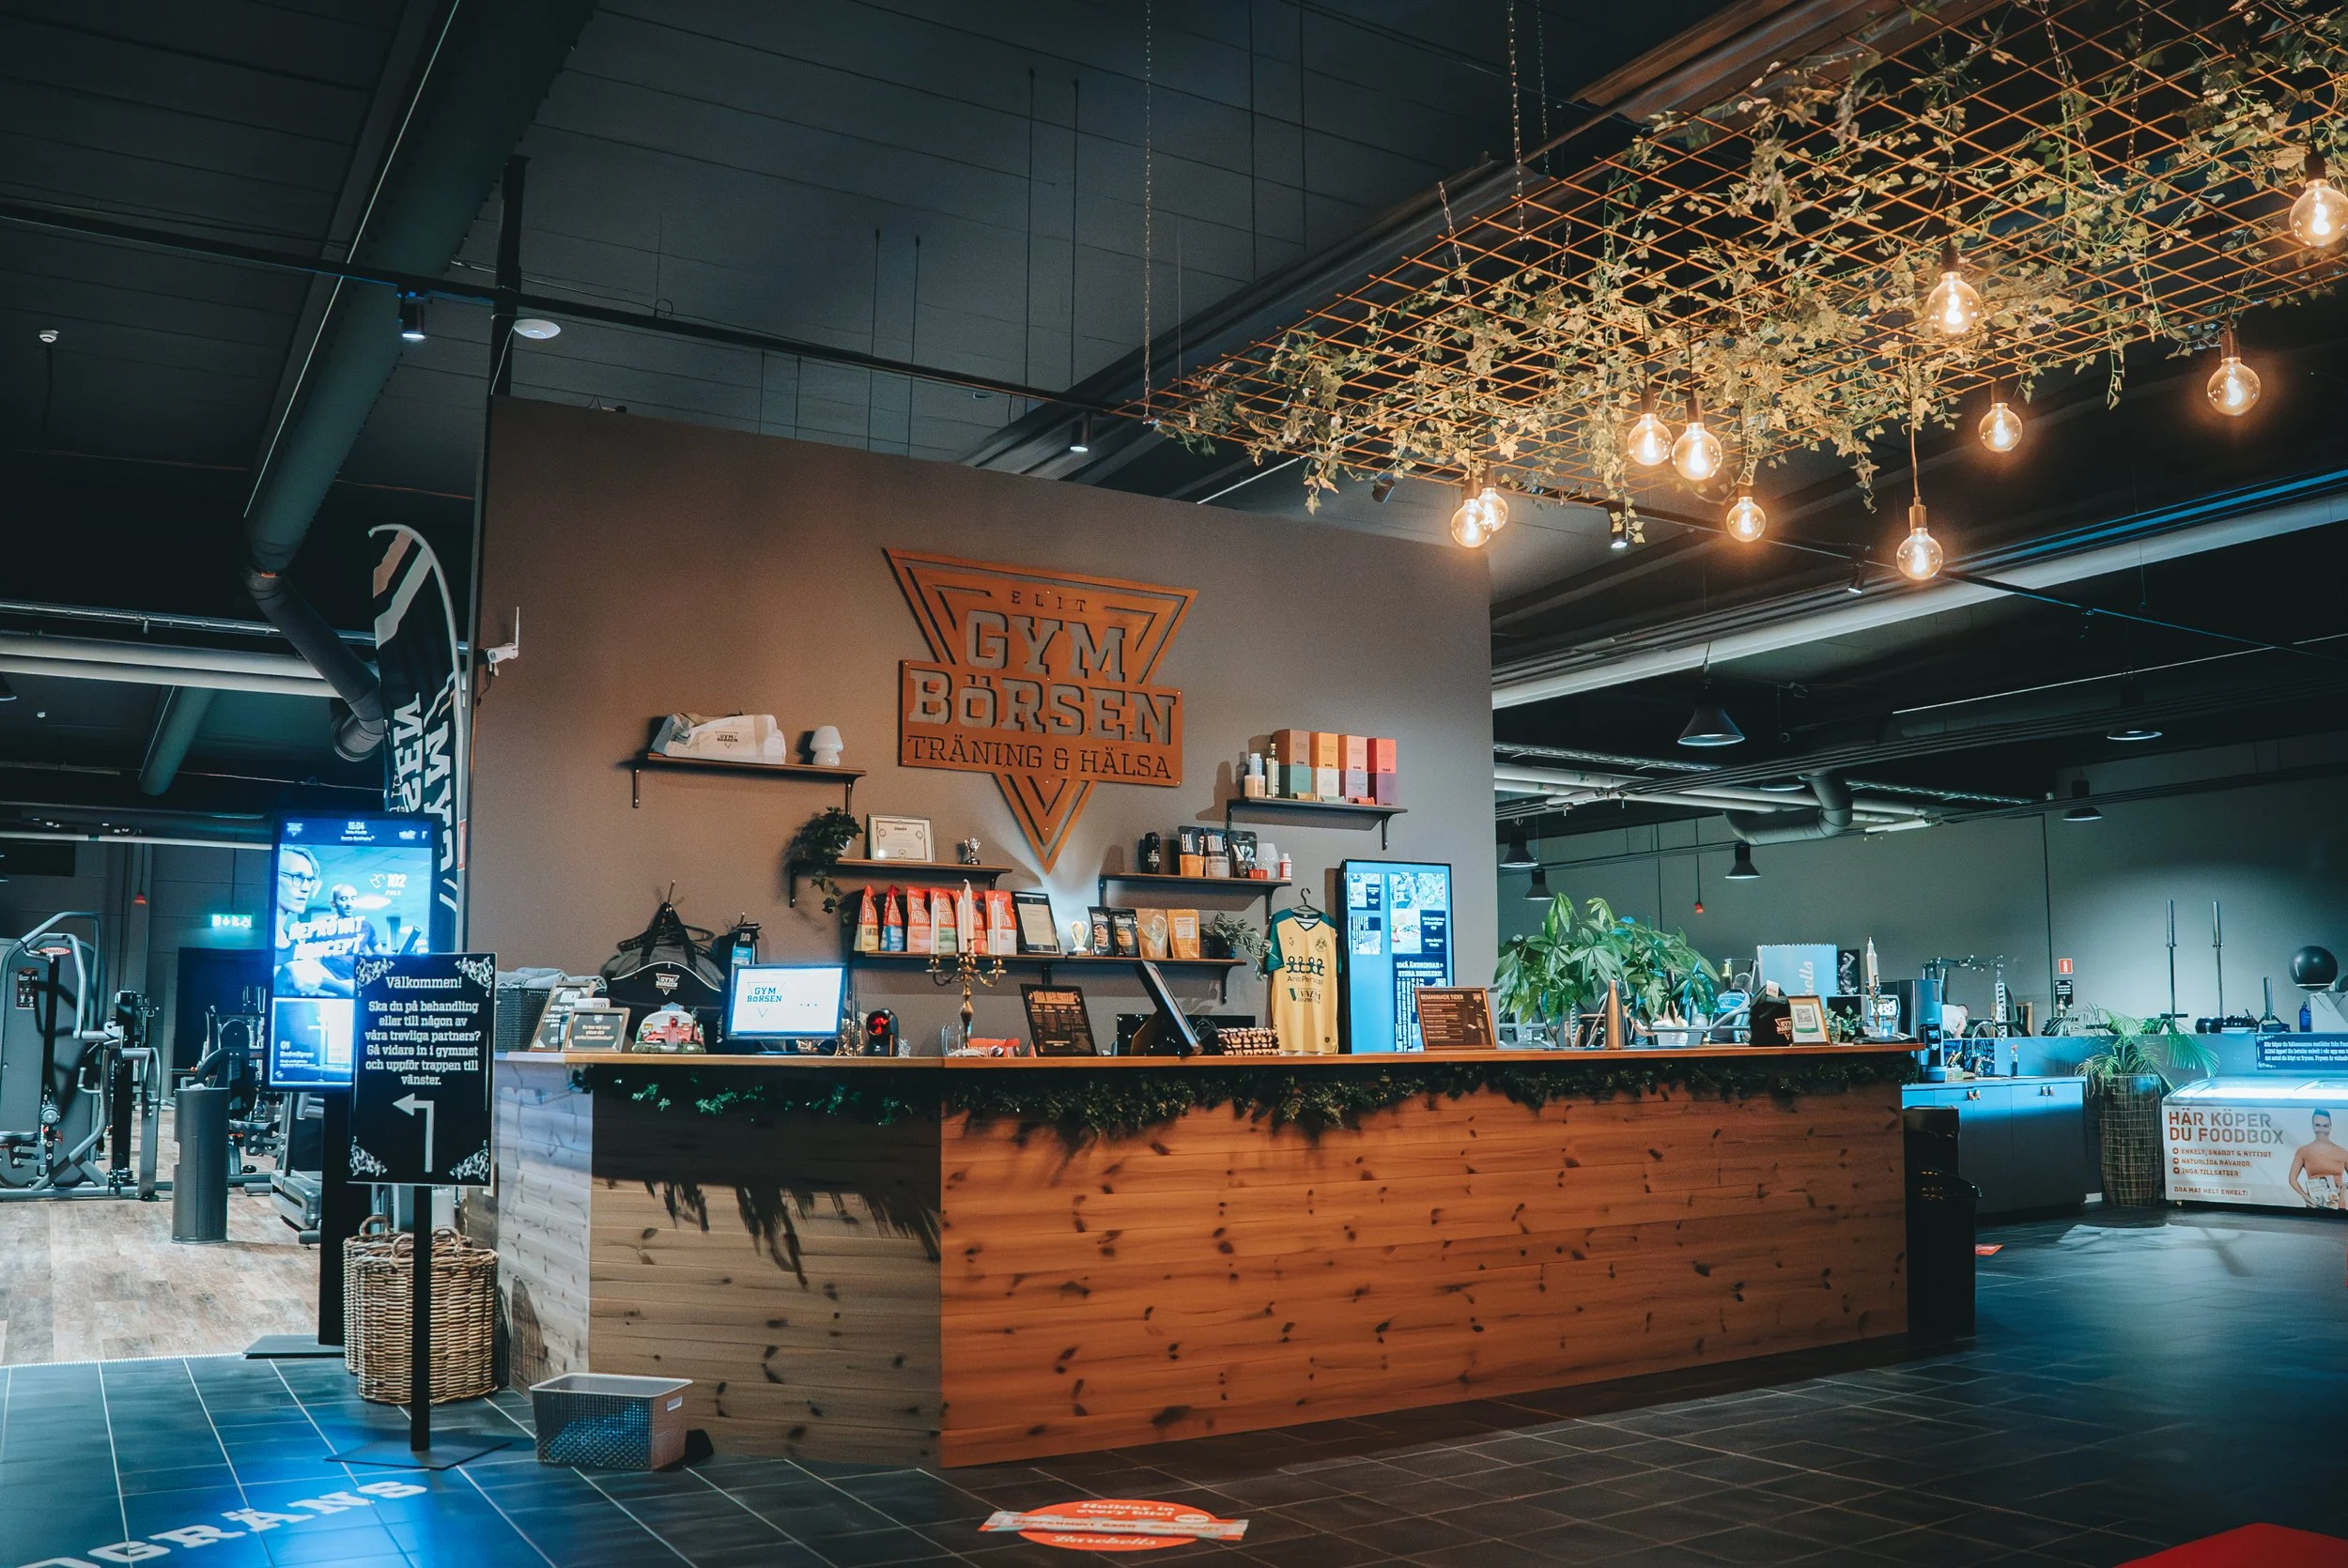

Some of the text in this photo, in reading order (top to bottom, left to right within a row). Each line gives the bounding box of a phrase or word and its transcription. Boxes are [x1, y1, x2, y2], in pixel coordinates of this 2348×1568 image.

[1011, 590, 1088, 612] ELIT
[965, 609, 1126, 684] GYM
[907, 668, 1177, 746] BÖRSEN
[907, 734, 1172, 779] TRÄNING & HÄLSA
[385, 976, 462, 989] Välkommen!
[1798, 961, 1815, 996] bells
[754, 987, 777, 995] GYM
[368, 1000, 479, 1014] Ska du på behandling
[378, 1015, 468, 1028] eller till någon av
[364, 1029, 482, 1043] våra trevliga partners?
[367, 1045, 478, 1058] Gå vidare in i gymmet
[365, 1059, 478, 1072] och uppför trappen till
[401, 1074, 441, 1085] vänster.
[2169, 1107, 2272, 1128] HÄR KÖPER
[2169, 1127, 2284, 1145] DU FOODBOX
[1081, 1503, 1152, 1512] Holiday
[1051, 1534, 1157, 1547] Barebells
